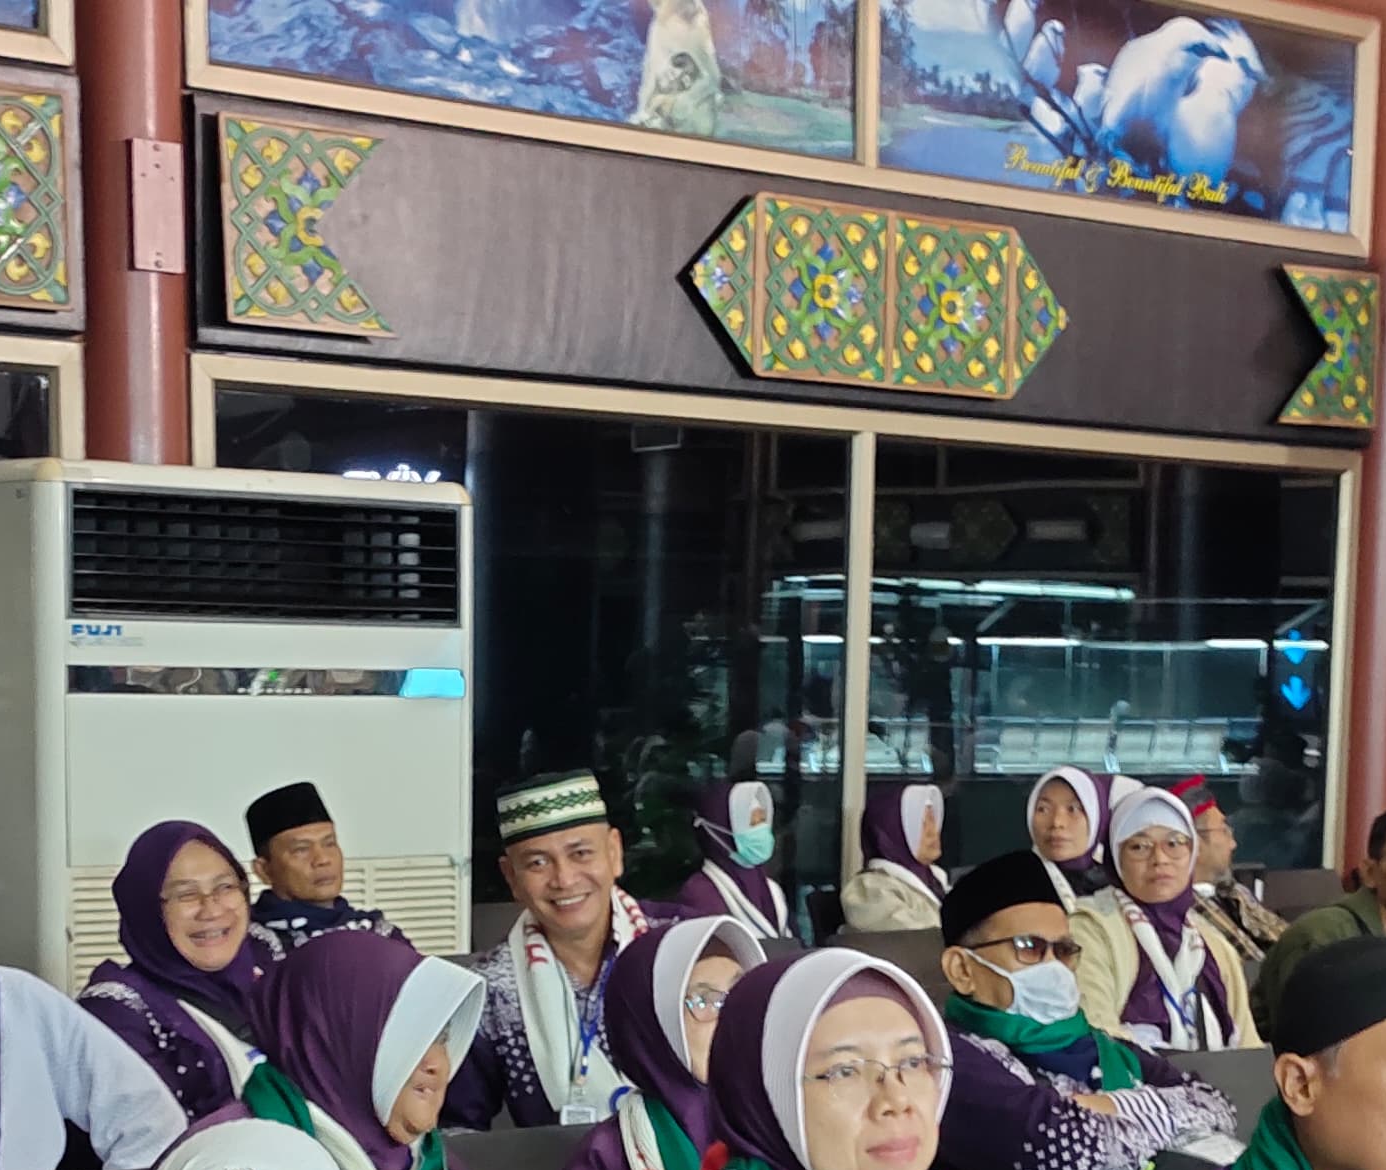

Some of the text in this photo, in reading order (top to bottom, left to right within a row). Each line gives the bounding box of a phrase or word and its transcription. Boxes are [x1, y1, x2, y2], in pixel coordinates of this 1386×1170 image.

[1006, 142, 1086, 189] Beautiful
[1107, 157, 1187, 206] Bountiful
[1187, 171, 1230, 205] Bali
[70, 623, 123, 637] FUJI
